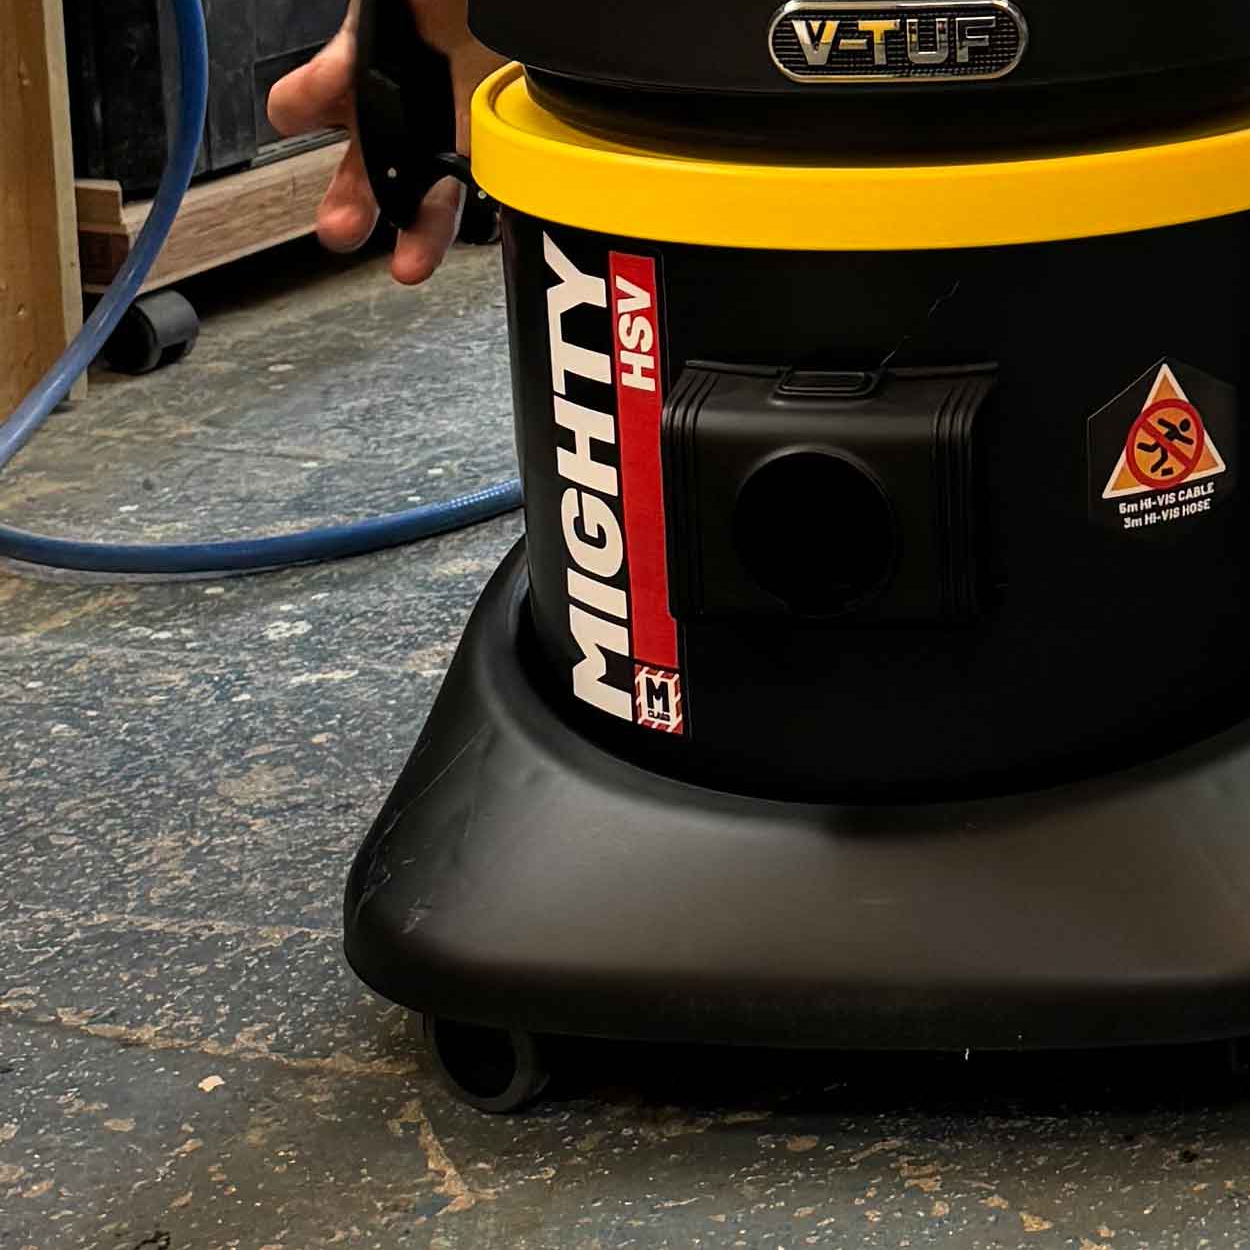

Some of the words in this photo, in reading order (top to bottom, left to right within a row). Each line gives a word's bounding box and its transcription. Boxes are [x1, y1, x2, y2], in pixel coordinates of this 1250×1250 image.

[791, 16, 997, 66] V-TUF
[615, 275, 656, 392] HSV
[542, 230, 633, 722] MIGHTY
[1140, 493, 1175, 510] HI-VIS
[1178, 482, 1215, 502] CABLE
[1123, 516, 1143, 529] 3m
[1144, 506, 1180, 525] HI-VIS
[1182, 498, 1212, 517] HOSE
[645, 676, 671, 713] M
